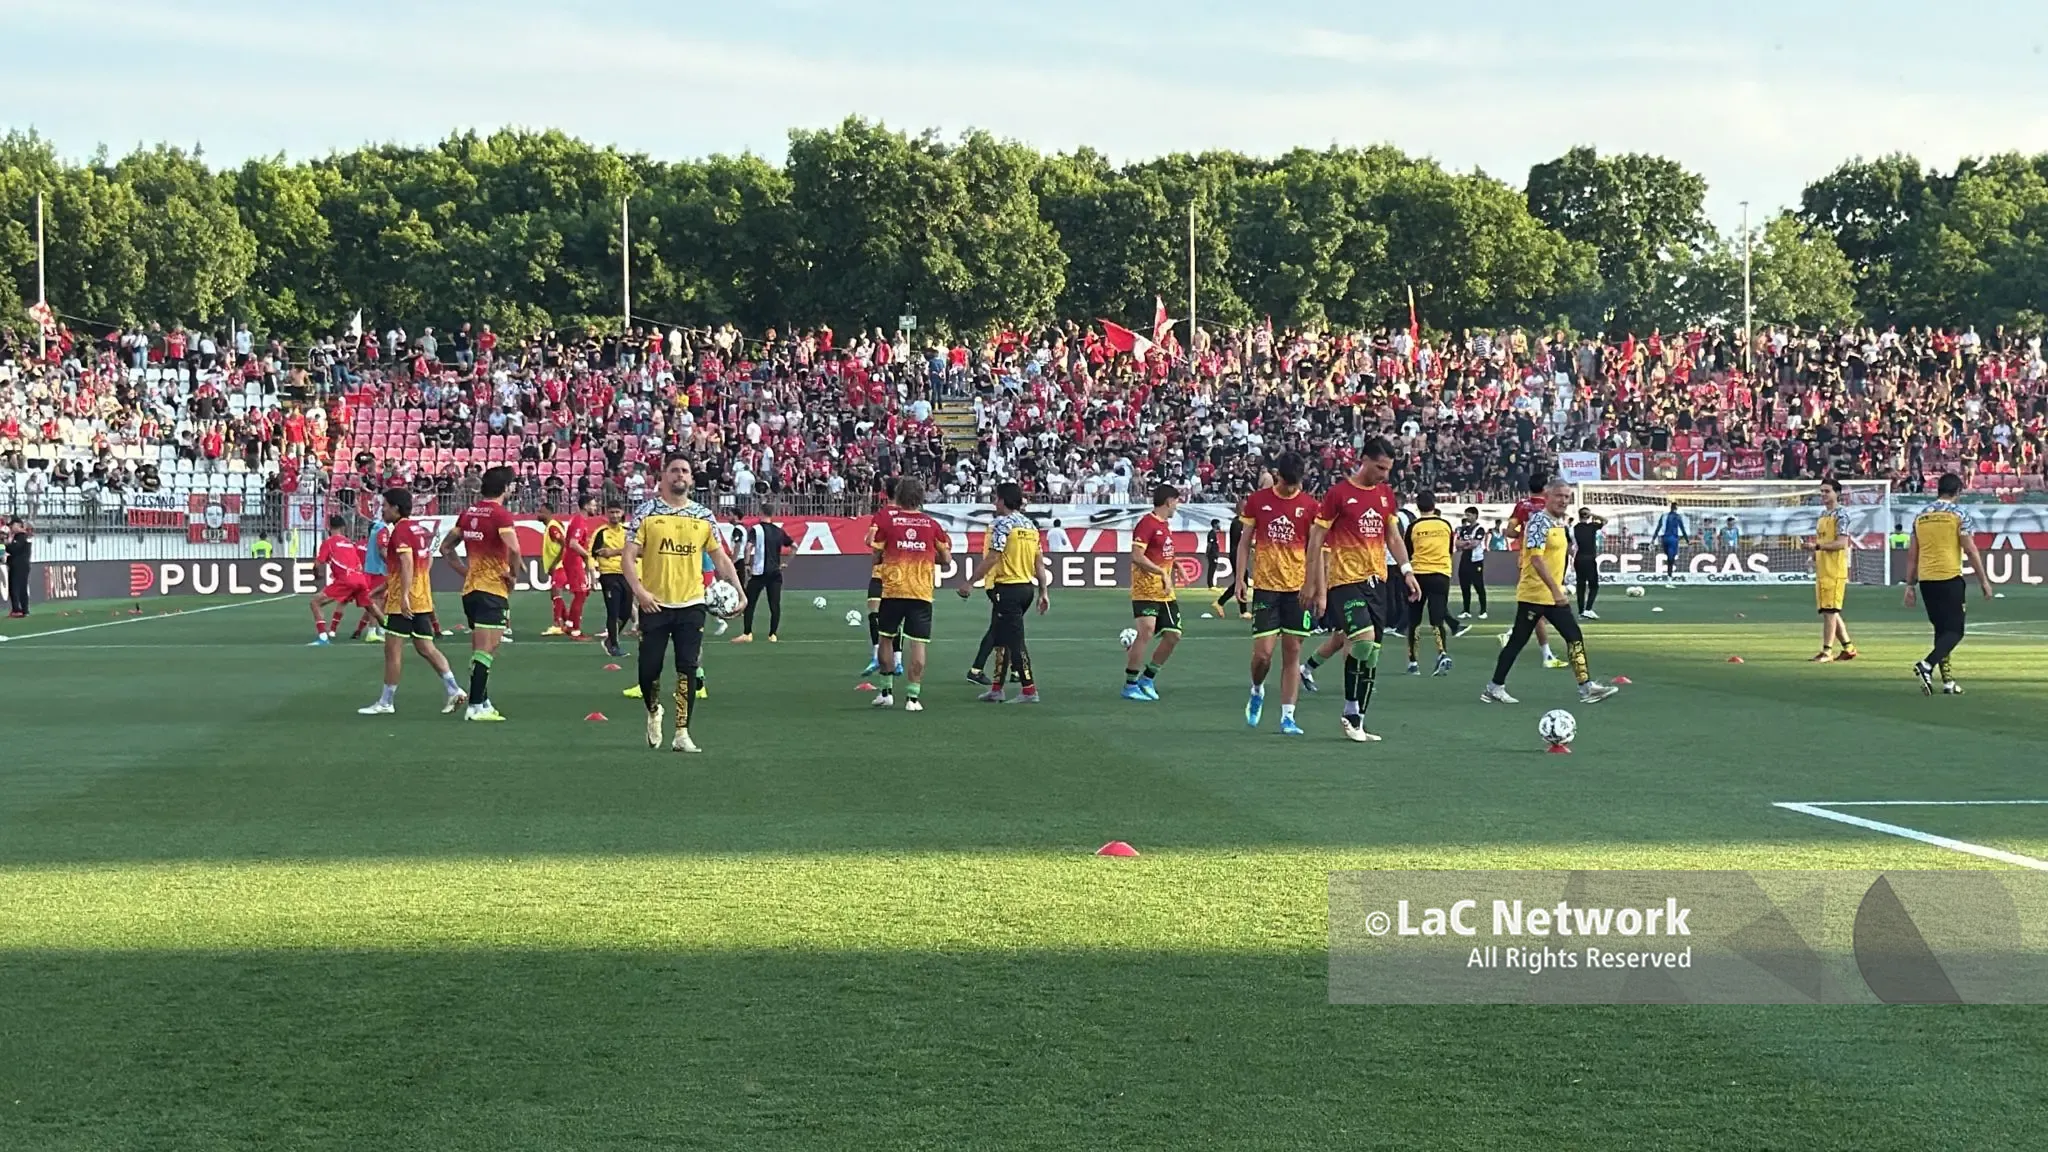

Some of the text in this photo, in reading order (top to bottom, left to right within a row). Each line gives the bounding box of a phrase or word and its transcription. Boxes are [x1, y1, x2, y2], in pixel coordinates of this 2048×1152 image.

[135, 494, 175, 509] CESANO
[1267, 523, 1296, 535] SANTA
[1358, 520, 1384, 528] SANTA
[1267, 531, 1294, 541] CROCE
[659, 537, 697, 556] Magis
[896, 540, 927, 550] PARCO
[1689, 553, 1771, 573] GAS
[1707, 574, 1758, 583] GoldBet
[1302, 610, 1312, 630] 6
